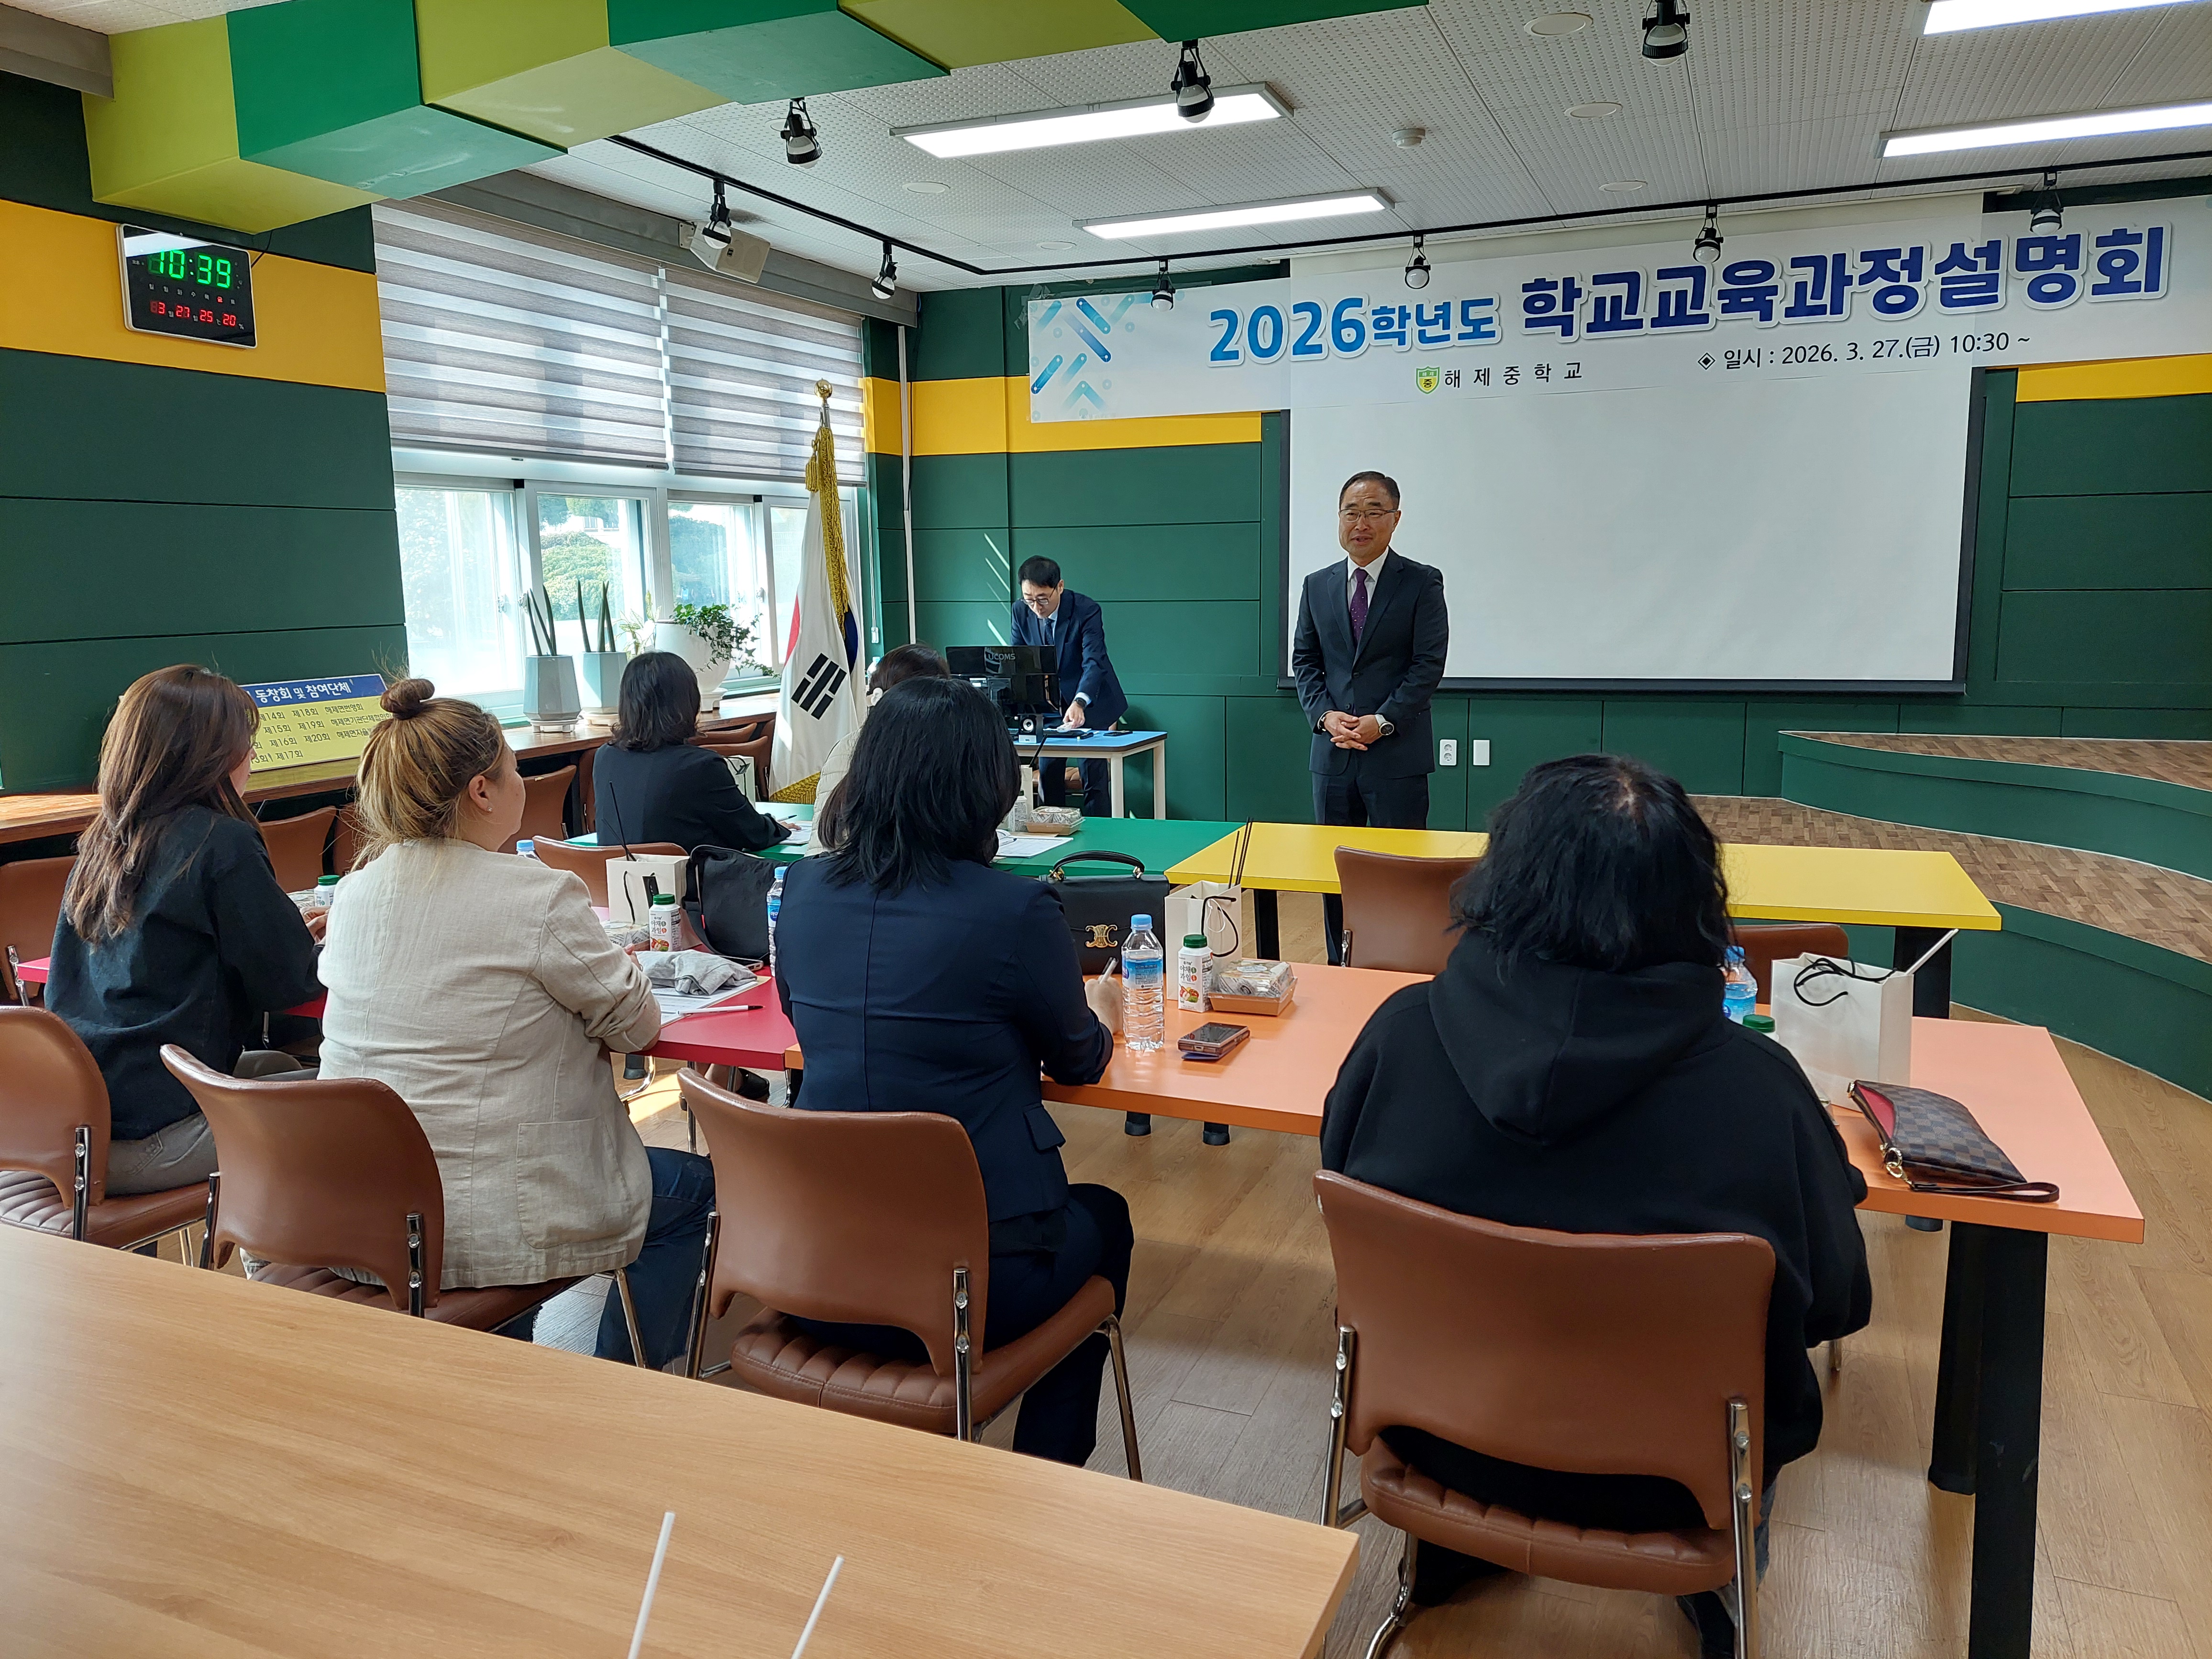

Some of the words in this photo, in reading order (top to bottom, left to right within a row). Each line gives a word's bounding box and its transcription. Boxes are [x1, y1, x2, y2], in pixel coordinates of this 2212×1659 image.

[160, 250, 231, 288] 10:39
[1209, 298, 1496, 362] 2026학년도
[1522, 226, 2163, 337] 학교교육과정설명회
[158, 302, 166, 314] 3
[176, 305, 190, 318] 27
[199, 310, 213, 322] 25
[223, 314, 236, 326] 20
[1724, 347, 1761, 369] 일시
[1781, 343, 1838, 365] 2026.
[1846, 342, 1864, 361] 3.
[1872, 334, 1940, 359] 27.(금)
[1950, 332, 2009, 353] 10:30
[256, 687, 293, 703] 동창회
[293, 687, 304, 699] 및
[305, 682, 352, 698] 참여단체
[291, 708, 319, 718] 제18회
[263, 724, 292, 734] 제15회
[298, 720, 325, 730] 제19회
[269, 737, 298, 748] 제16회
[303, 733, 331, 743] 제20회
[336, 728, 371, 739] 해제면자율
[275, 750, 303, 761] 제17회
[1180, 965, 1191, 974] 야채
[1180, 973, 1191, 982] 과일
